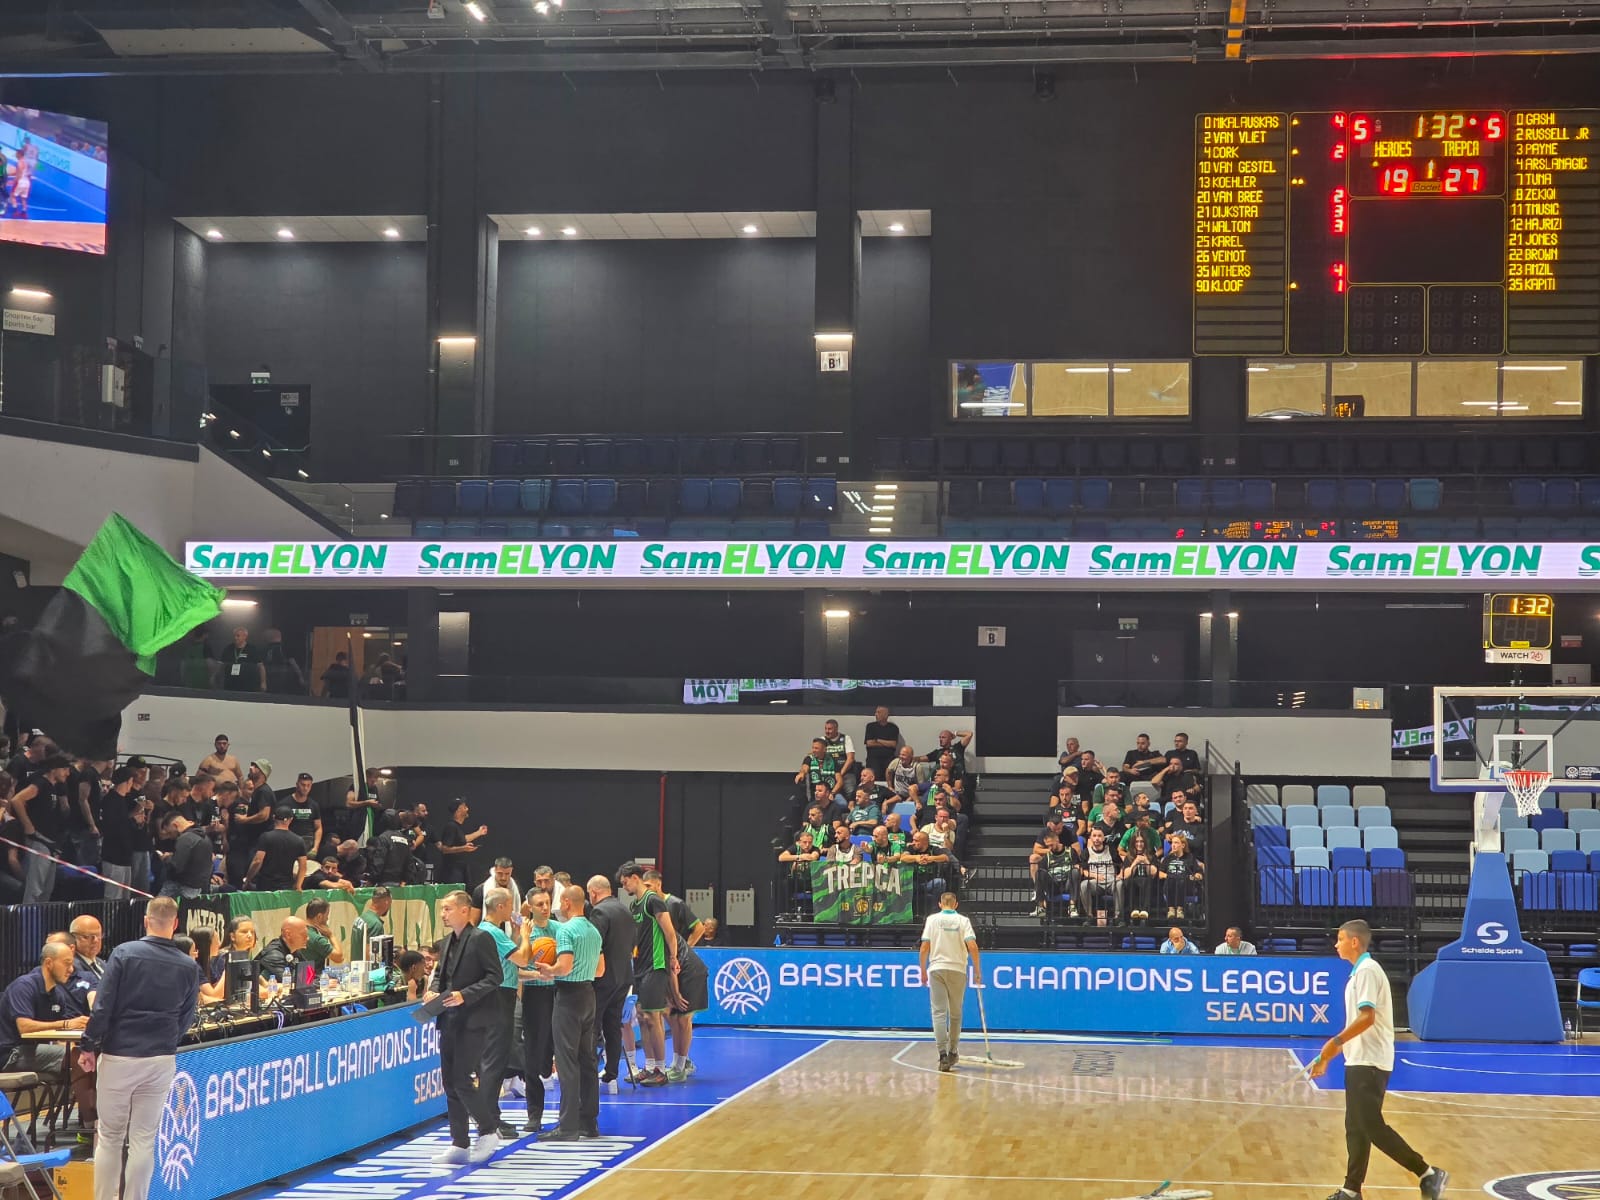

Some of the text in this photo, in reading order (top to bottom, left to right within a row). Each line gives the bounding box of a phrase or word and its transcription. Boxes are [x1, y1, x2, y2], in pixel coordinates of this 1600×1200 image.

[1334, 114, 1345, 128] 4
[1526, 113, 1555, 125] GASHI
[1353, 119, 1367, 140] 5
[1417, 114, 1464, 138] 1:32
[1487, 117, 1501, 139] 5
[1204, 131, 1267, 144] 2 VAN VLIET
[1516, 127, 1589, 140] 2 RUSSELL JR
[1203, 146, 1239, 158] 4 CORK
[1334, 145, 1344, 158] 2
[1374, 141, 1412, 157] HEROES
[1442, 141, 1480, 157] TREPCA
[1516, 143, 1558, 155] 3 PAYNE
[1199, 161, 1277, 173] 10 VAN GESTEL
[1427, 160, 1434, 179] 1
[1516, 157, 1587, 170] 4 ARSLANAGIC
[1199, 176, 1256, 188] 13 KOEHLER
[1383, 168, 1408, 192] 19
[1445, 168, 1479, 192] 27
[1516, 173, 1552, 185] 7 TUNA
[1197, 190, 1263, 203] 20 VAN BREE
[1333, 189, 1344, 203] 2
[1516, 188, 1556, 200] 8 ZEKIQI
[1197, 205, 1258, 218] 21 DIJKSTRA
[1334, 204, 1344, 218] 3
[1511, 203, 1560, 215] 11 TMUSIC
[1197, 220, 1251, 232] 24 WALTON
[1334, 219, 1344, 232] 3
[1510, 218, 1562, 230] 12 HAJRIZI
[1196, 235, 1244, 247] 25 KAREL
[1509, 233, 1558, 245] 21 JONES
[1196, 250, 1246, 262] 26 VEINOT
[1509, 248, 1558, 260] 22 BROWN
[1196, 265, 1251, 277] 35 WITHERS
[1333, 263, 1343, 277] 4
[1509, 263, 1553, 275] 23 AMZIL
[1196, 279, 1244, 292] 90 KLOOF
[1337, 279, 1343, 292] 1
[1508, 278, 1556, 291] 35 KAPITI
[190, 544, 387, 575] SamELYON
[418, 544, 617, 575] SamELYON
[640, 544, 846, 575] SamELYON
[863, 544, 1070, 575] SamELYON
[1089, 545, 1298, 576] SamELYON
[1326, 545, 1543, 576] SamELYON
[1511, 597, 1549, 615] 1:32
[988, 632, 996, 645] B
[1500, 652, 1529, 660] WATCH
[823, 861, 902, 896] TREPCA
[1495, 947, 1523, 956] Sports
[779, 962, 1330, 995] BASKETBL CHAMPIONS LEAGUE
[1206, 1001, 1330, 1023] SEASON X
[204, 1020, 441, 1120] BASKETBALL CHAMPIONS LEA
[413, 1066, 445, 1105] SEASO
